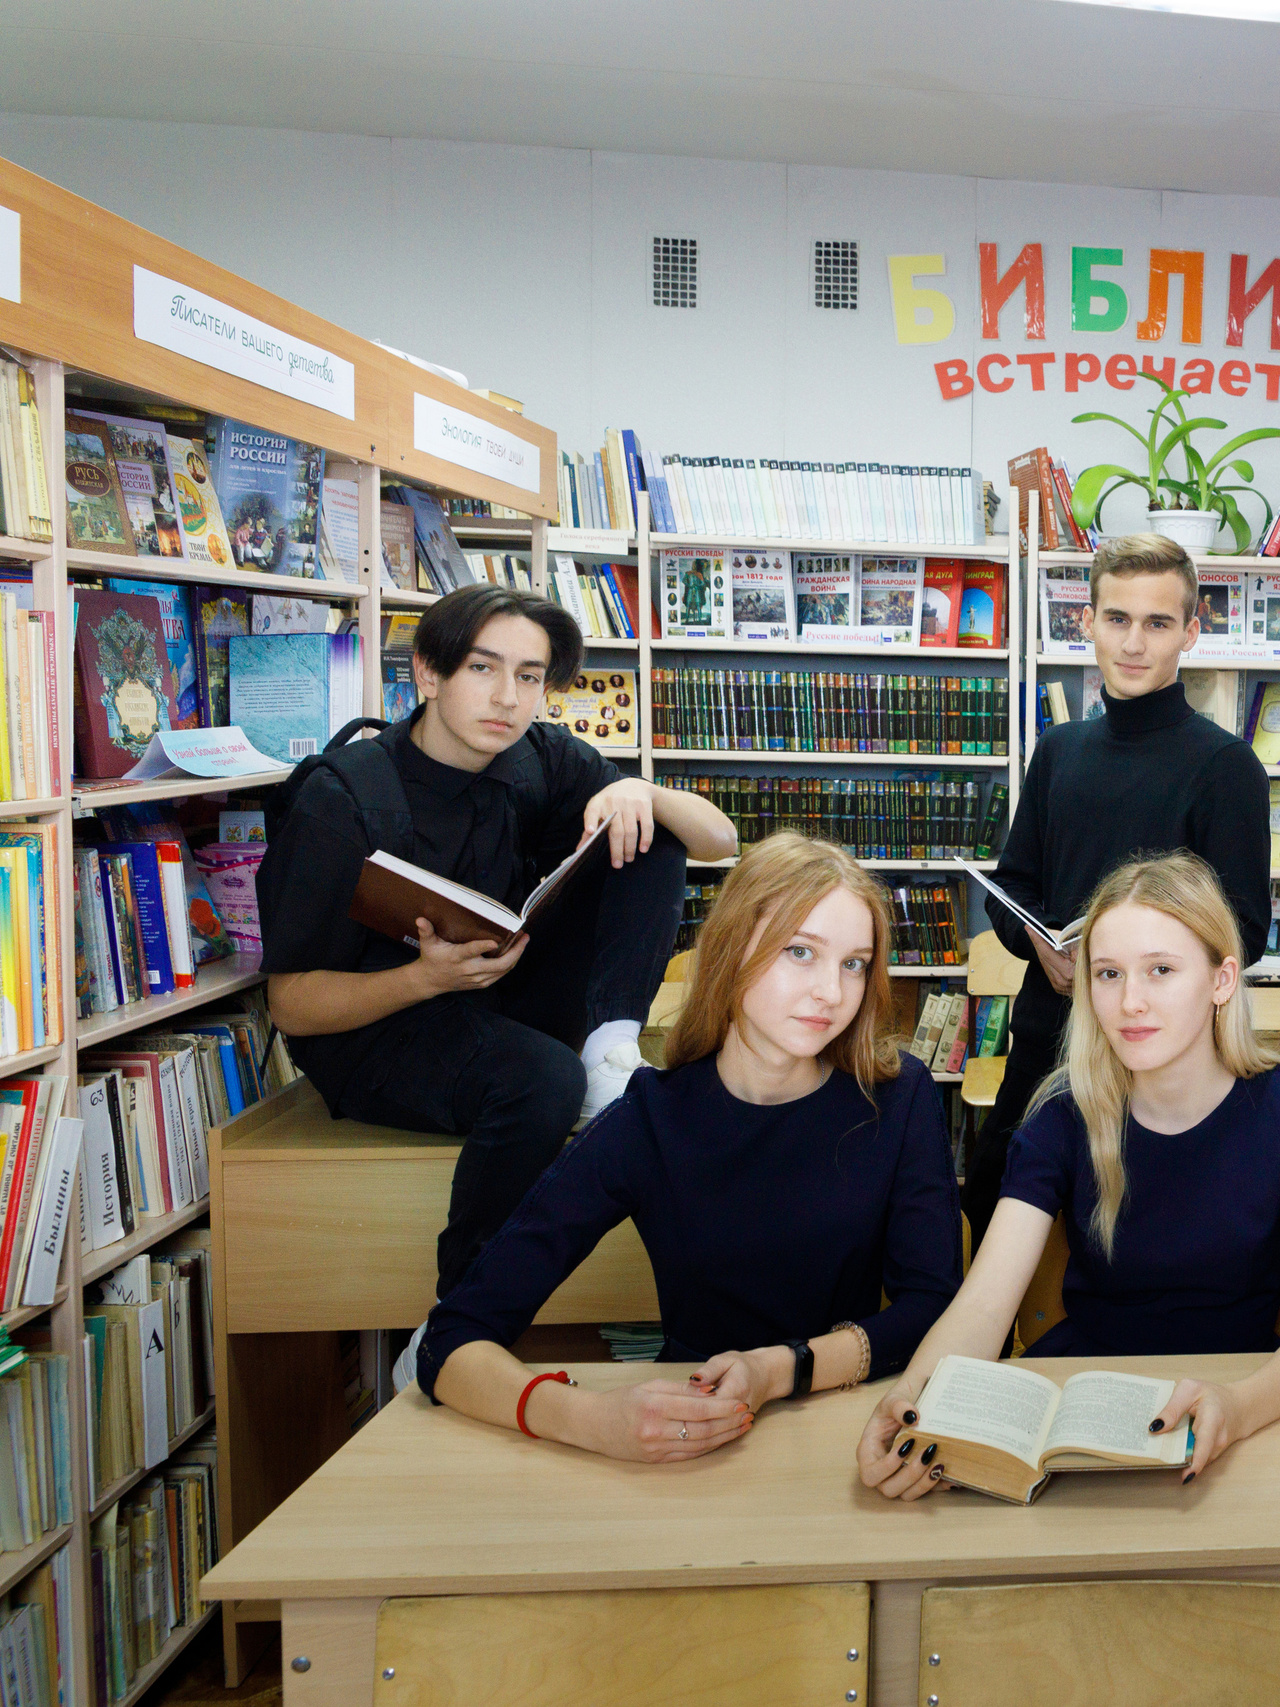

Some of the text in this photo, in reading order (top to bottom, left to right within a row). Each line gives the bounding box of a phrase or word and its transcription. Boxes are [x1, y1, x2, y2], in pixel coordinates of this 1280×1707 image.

[241, 330, 283, 362] ВАШЕГО
[288, 351, 335, 385] детства
[231, 432, 288, 450] ИСТОРИЯ
[230, 446, 286, 465] РОССИИ
[74, 466, 100, 481] РУСЬ
[119, 471, 150, 482] СТОРИЯ
[121, 481, 152, 491] ОССИИ
[665, 549, 724, 558] РУССКИЕ ПОБЕДЫ
[797, 576, 850, 584] ГРАЖДАНСКАЯ
[861, 578, 880, 586] ОЙНА
[935, 571, 954, 579] ДУГА
[810, 584, 837, 592] ВОЙНА
[1061, 585, 1089, 593] РУССКИЕ
[806, 630, 841, 641] Русские
[171, 746, 196, 760] Узнай
[195, 744, 222, 757] больше
[228, 742, 248, 753] своей
[90, 1089, 105, 1107] 63
[183, 1096, 204, 1162] Юные герои
[9, 1121, 21, 1158] СЧИТАЛКИ
[18, 1117, 44, 1224] РУССКИЕ БЫЛИНЫ
[101, 1152, 116, 1227] История
[43, 1169, 70, 1256] Былины
[145, 1327, 165, 1360] А
